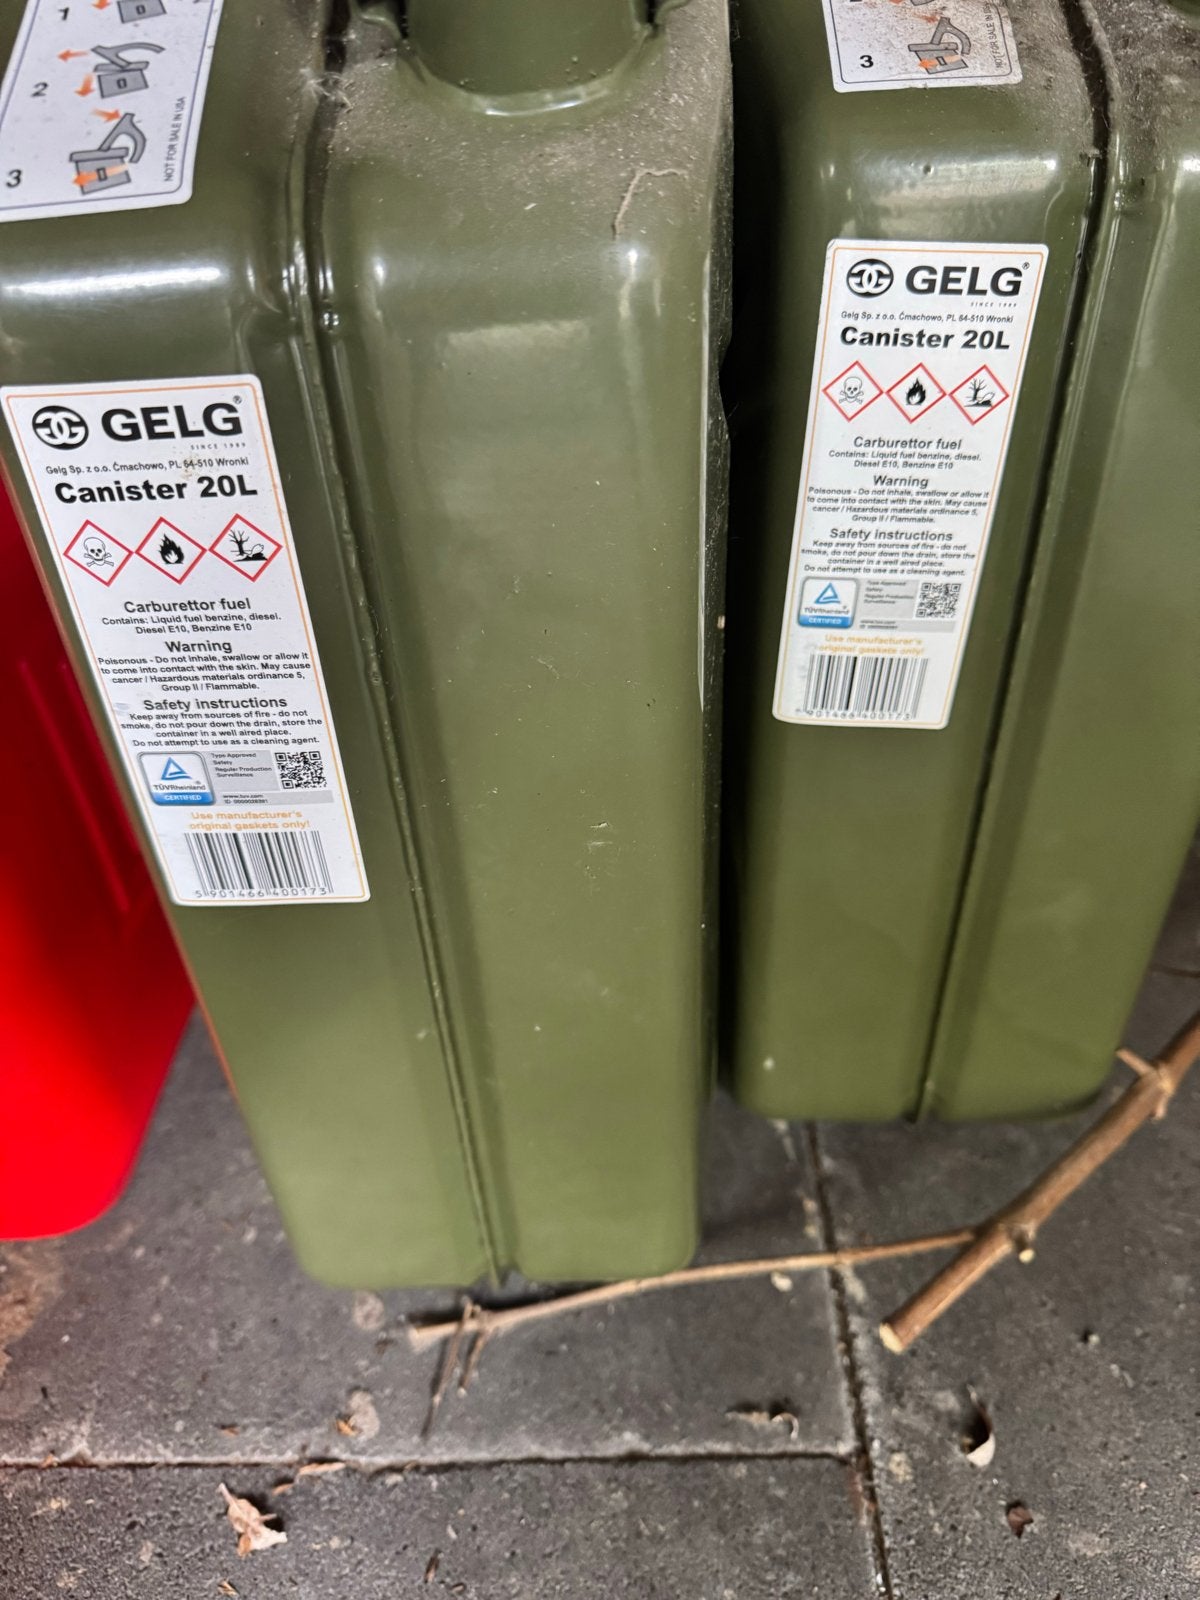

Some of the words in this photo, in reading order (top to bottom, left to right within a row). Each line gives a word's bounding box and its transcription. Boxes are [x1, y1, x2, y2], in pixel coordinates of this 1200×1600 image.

[58, 7, 70, 21] 1
[986, 22, 997, 40] SALE
[860, 55, 874, 68] 3
[31, 82, 49, 97] 2
[175, 96, 187, 113] USA
[172, 113, 183, 122] IN
[168, 123, 182, 142] SALE
[165, 143, 178, 161] FOR
[6, 169, 22, 188] 3
[163, 163, 175, 182] NOT
[840, 310, 860, 321] Gelg
[860, 311, 874, 321] Sp.
[881, 313, 897, 321] o.o.
[898, 310, 944, 323] Ćmachowo,
[945, 313, 957, 322] PL
[958, 314, 985, 323] 64-510
[986, 314, 1014, 324] Wronki
[840, 326, 955, 348] Canister
[961, 329, 1010, 350] 20L
[190, 443, 218, 451] SINCE
[853, 435, 934, 449] Carburettor
[936, 438, 963, 450] fuel
[828, 449, 869, 459] Contains:
[871, 450, 899, 460] Liquid
[899, 451, 916, 460] fuel
[917, 452, 952, 461] benzine,
[954, 452, 982, 462] diesel.
[45, 465, 68, 476] Gelg
[68, 464, 85, 475] Sp.
[85, 465, 93, 473] z
[93, 465, 112, 473] o.o.
[112, 461, 168, 472] Ćmachowo,
[167, 460, 183, 469] PL
[182, 458, 214, 470] 64-510
[214, 456, 249, 467] Wronki
[853, 459, 881, 468] Diesel
[881, 459, 900, 469] E10,
[901, 460, 936, 469] Benzine
[937, 461, 954, 470] E10
[54, 479, 188, 504] Canister
[196, 474, 258, 498] 20L
[873, 474, 929, 490] Warning
[851, 514, 878, 523] Group
[878, 514, 885, 522] II
[889, 515, 935, 524] Flammable.
[829, 527, 872, 541] Safety
[874, 528, 953, 542] instructions
[123, 599, 216, 614] Carburettor
[219, 597, 252, 610] fuel
[101, 616, 149, 626] Contains:
[150, 614, 182, 625] Liquid
[183, 614, 203, 623] fuel
[204, 613, 247, 622] benzine,
[248, 612, 282, 621] diesel.
[807, 616, 842, 625] CERTIFIED
[134, 625, 167, 635] Diesel
[167, 624, 190, 634] E10,
[191, 624, 232, 633] Benzine
[232, 622, 253, 632] E10
[164, 639, 233, 654] Warning
[97, 657, 148, 665] Poisonous
[154, 655, 170, 664] Do
[170, 655, 188, 663] not
[187, 654, 221, 663] inhale,
[221, 653, 261, 662] swallow
[274, 652, 300, 661] allow
[301, 651, 309, 660] it
[100, 667, 111, 675] to
[139, 666, 158, 674] into
[159, 665, 196, 673] contact
[195, 664, 218, 672] with
[218, 663, 235, 672] the
[235, 662, 259, 671] skin.
[260, 662, 281, 672] May
[149, 674, 201, 683] Hazardous
[201, 672, 246, 681] materials
[247, 671, 295, 680] ordinance
[296, 671, 306, 680] 5,
[161, 684, 192, 693] Group
[192, 683, 199, 691] II
[204, 682, 260, 691] Flammable.
[143, 699, 191, 712] Safety
[194, 696, 288, 710] instructions
[128, 713, 154, 722] Keep
[155, 713, 179, 721] away
[180, 711, 203, 719] from
[243, 710, 253, 719] of
[254, 710, 271, 718] fire
[277, 710, 291, 718] do
[292, 709, 309, 717] not
[120, 722, 154, 730] smoke,
[168, 721, 185, 729] not
[185, 722, 208, 730] pour
[208, 720, 235, 728] down
[235, 720, 252, 728] the
[253, 719, 281, 728] drain,
[281, 719, 306, 727] store
[307, 718, 323, 726] the
[155, 730, 199, 738] container
[199, 729, 210, 737] in
[218, 729, 238, 737] well
[238, 728, 263, 737] aired
[263, 728, 292, 737] place.
[132, 739, 146, 747] Do
[147, 739, 164, 747] not
[164, 739, 199, 747] attempt
[250, 737, 290, 745] cleaning
[291, 736, 320, 745] agent.
[191, 812, 214, 820] Use
[216, 811, 303, 820] manufacturer's
[189, 823, 233, 832] original
[233, 822, 279, 831] gaskets
[281, 820, 310, 829] only!
